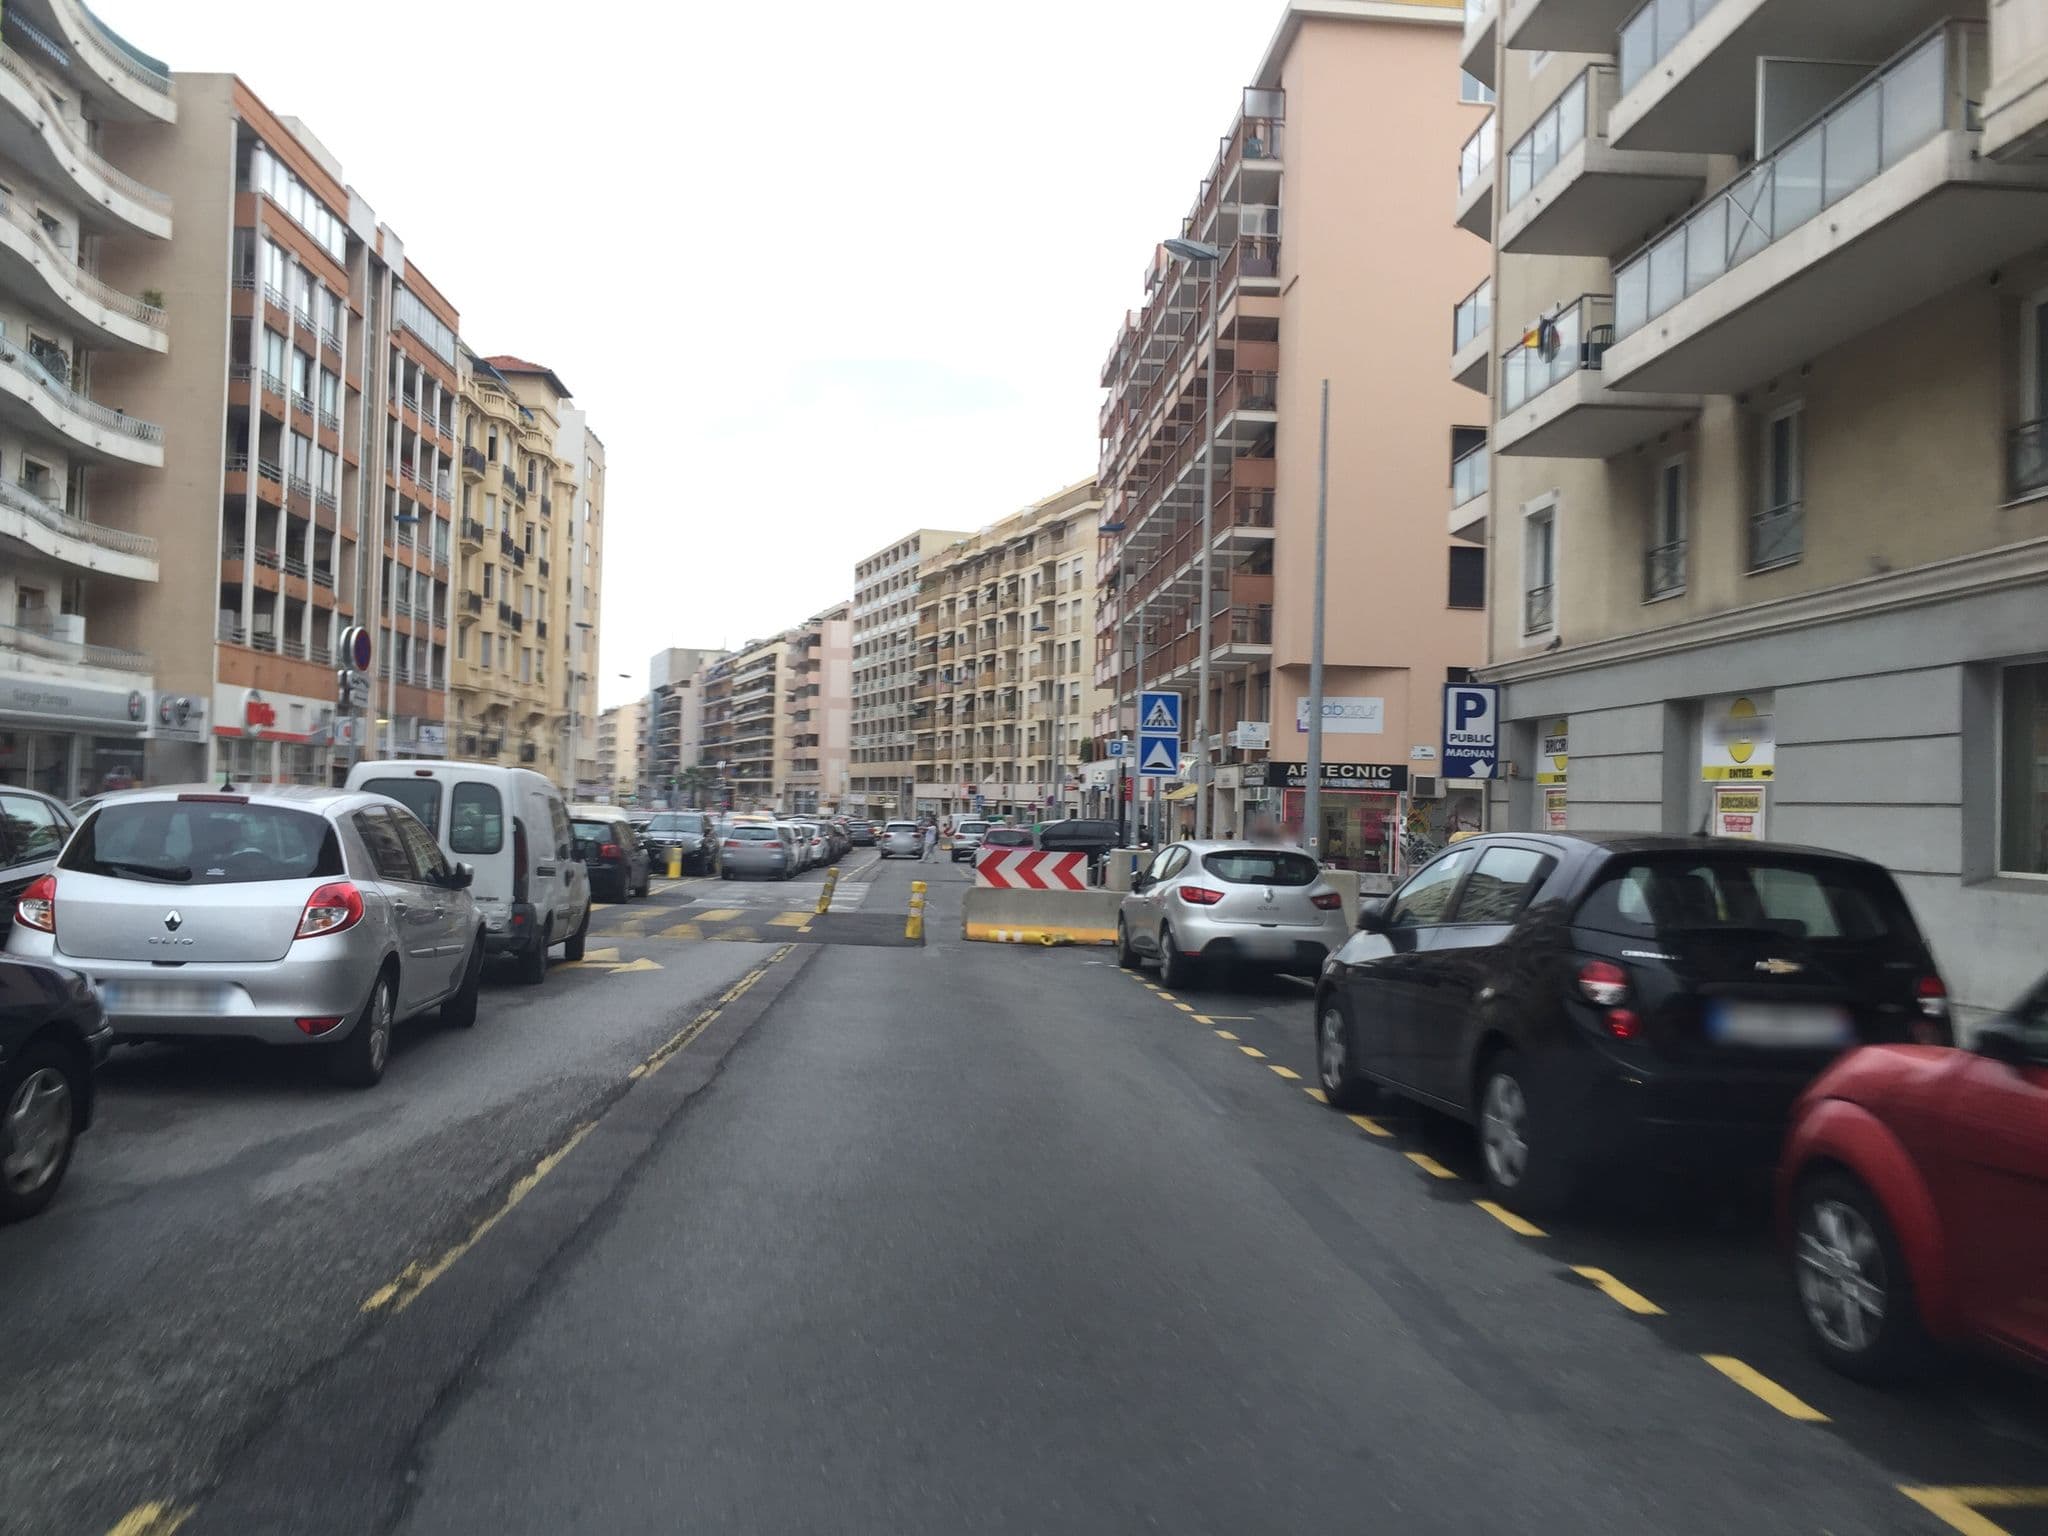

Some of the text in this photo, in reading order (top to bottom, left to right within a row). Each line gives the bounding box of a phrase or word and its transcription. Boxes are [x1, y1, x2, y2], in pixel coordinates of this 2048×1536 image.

[1456, 692, 1487, 730] P
[1449, 733, 1492, 743] PUBLIC
[1445, 748, 1495, 758] MAGNAN
[148, 936, 194, 945] CLIO
